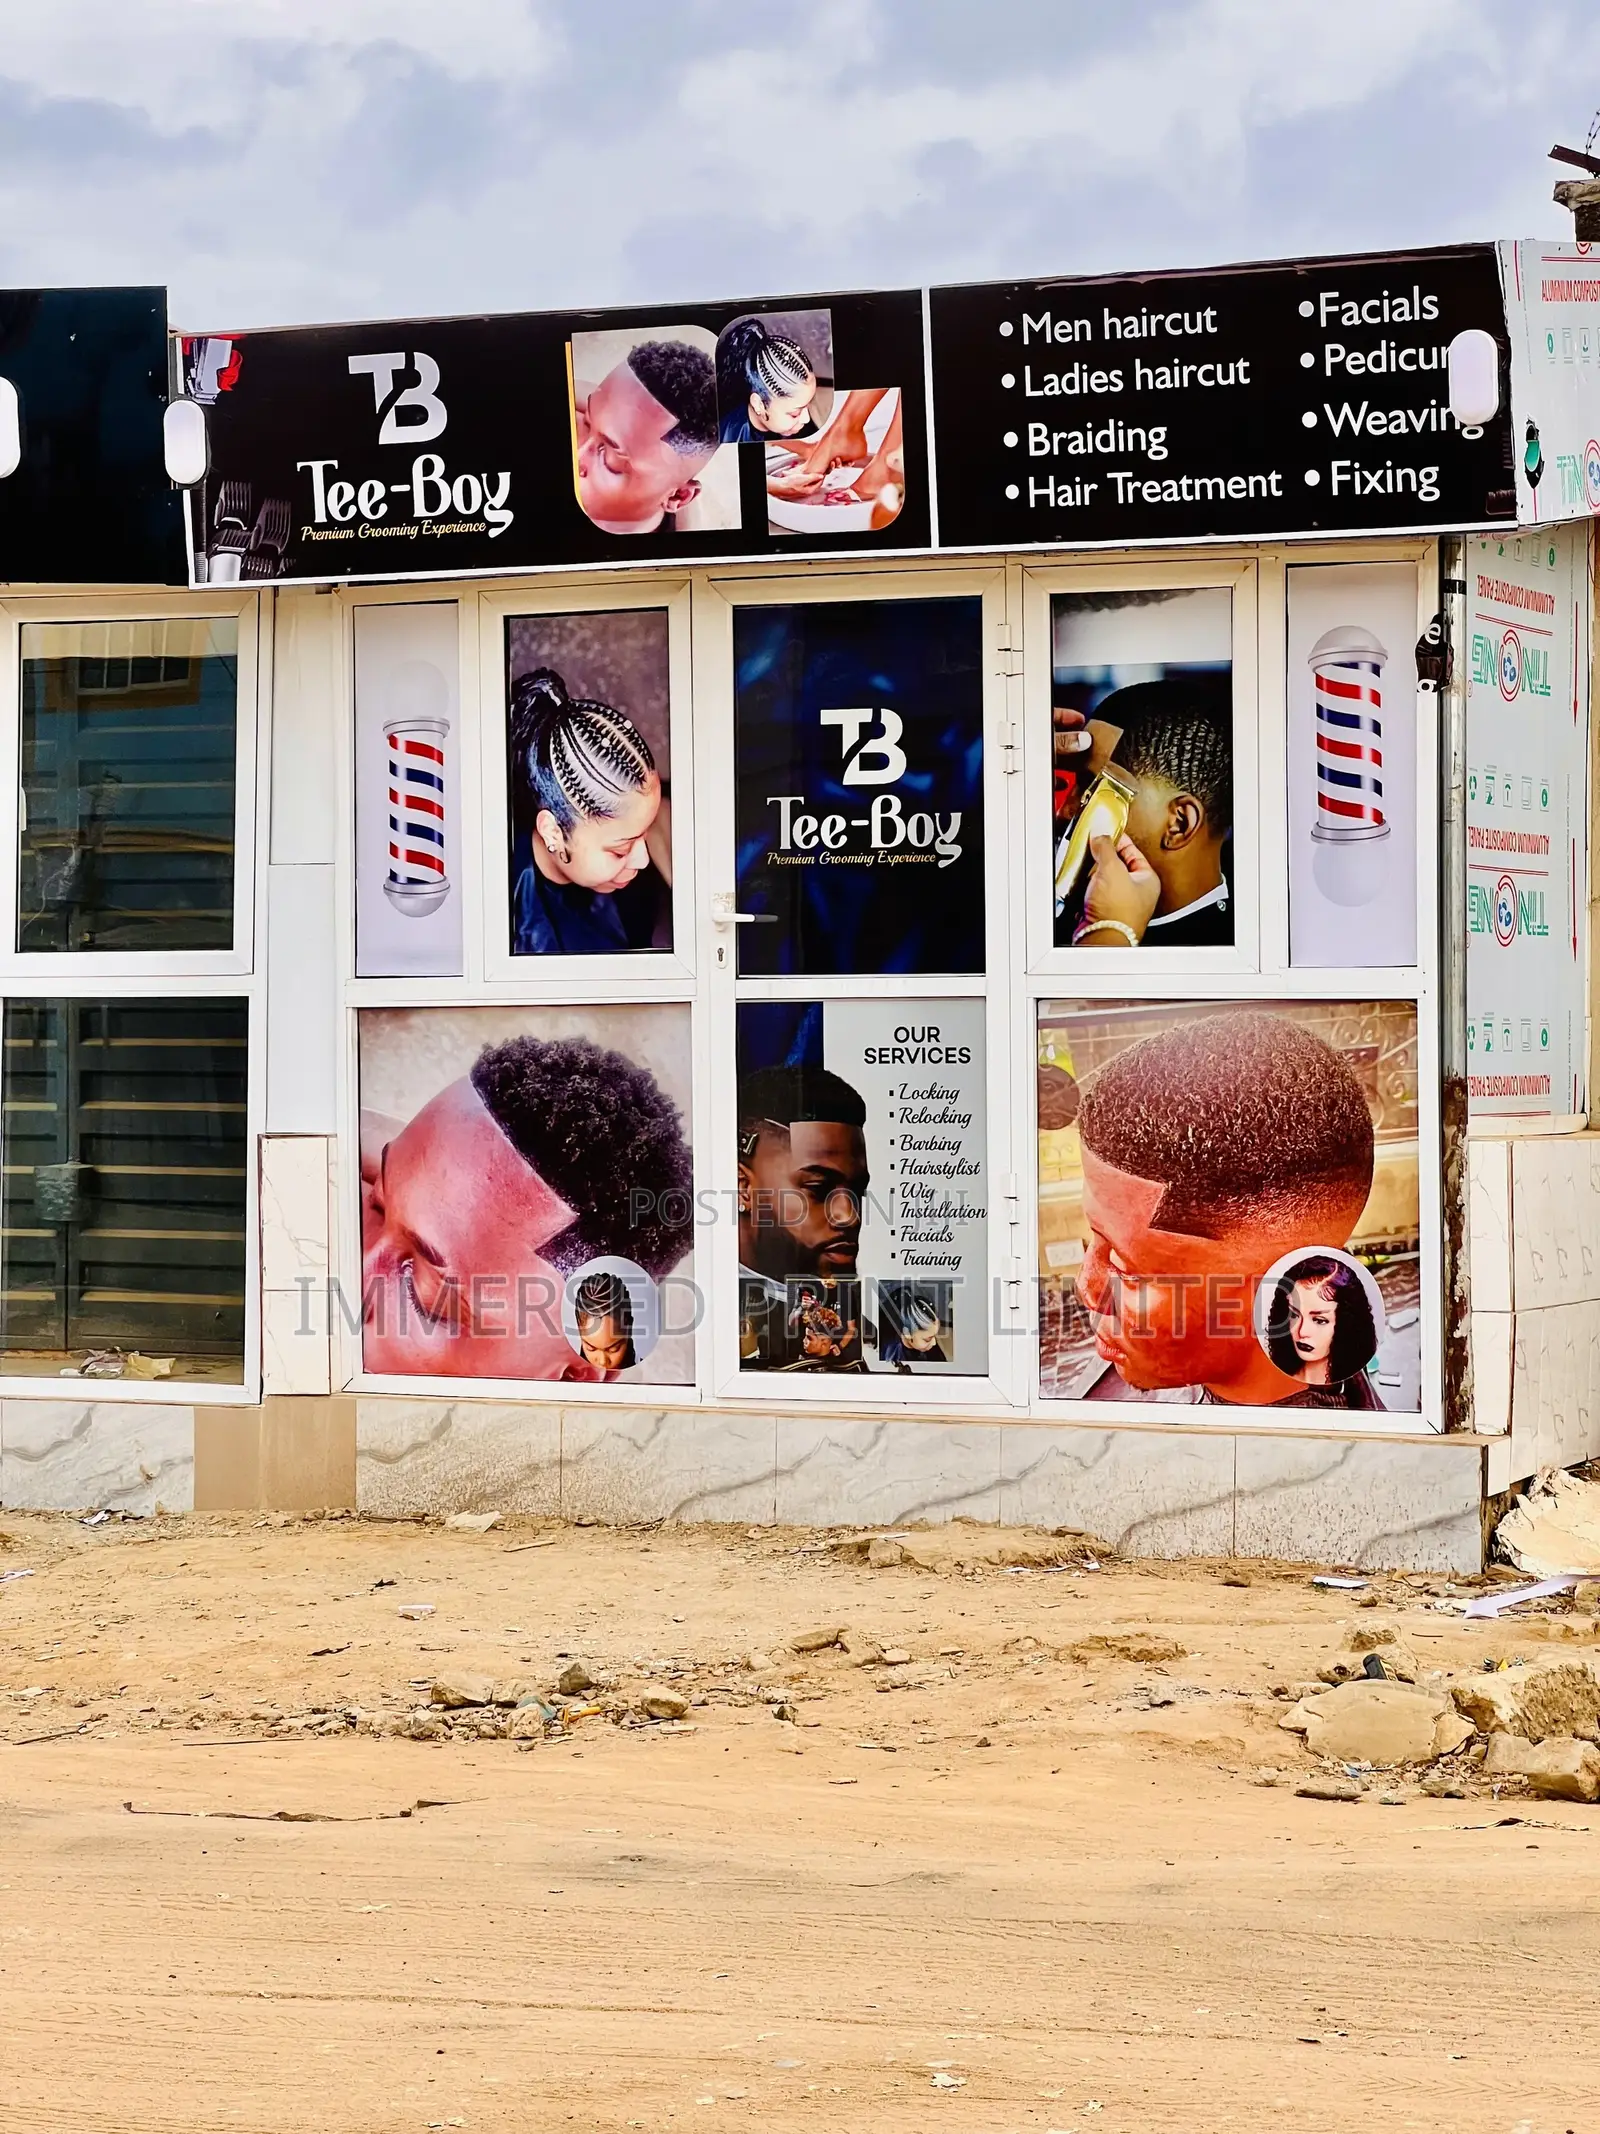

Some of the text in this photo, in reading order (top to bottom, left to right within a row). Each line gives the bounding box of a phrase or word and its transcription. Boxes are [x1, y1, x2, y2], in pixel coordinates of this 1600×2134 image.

[1320, 286, 1440, 327] Facials
[1022, 307, 1218, 345] Men haircut
[1324, 340, 1450, 377] Pedicur
[1024, 358, 1251, 397] Ladies haircut
[1028, 419, 1169, 461] Braiding
[1028, 470, 1283, 508] Hair Treatment
[1331, 460, 1441, 502] Fixing
[296, 454, 515, 538] Tee-Boy
[301, 519, 486, 541] Premium Grooming Experience
[766, 794, 963, 868] Tee-Boy
[767, 850, 936, 867] Premium Grooming Experience
[893, 1026, 941, 1044] OUR
[863, 1047, 971, 1065] SERVICES
[899, 1081, 961, 1105] Locking
[899, 1106, 973, 1129] Relocking
[900, 1134, 963, 1157] Barbing
[899, 1158, 981, 1180] Hairstylist
[899, 1181, 936, 1204] Wig
[899, 1201, 988, 1219] Installation
[900, 1225, 955, 1243] Facials
[900, 1248, 962, 1272] Training
